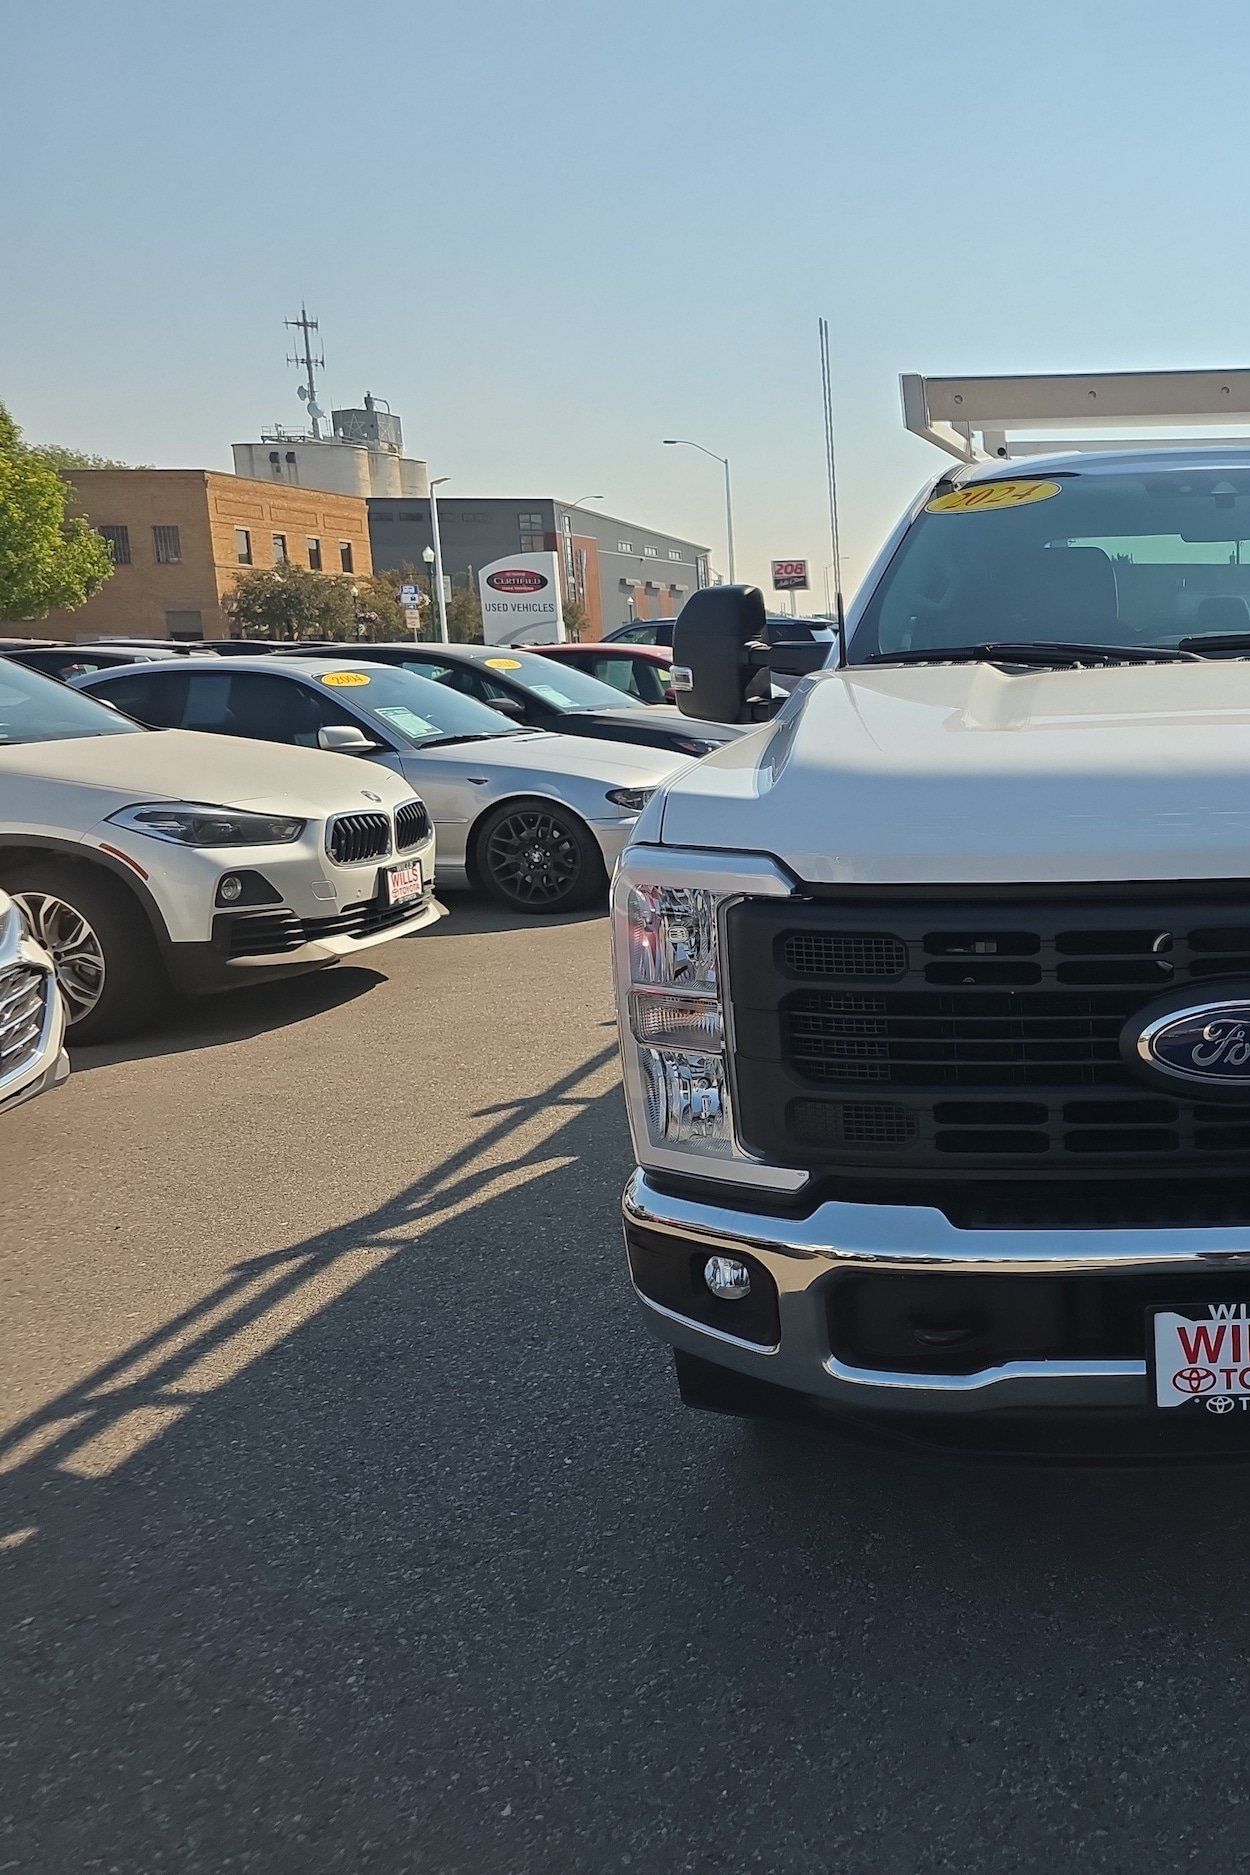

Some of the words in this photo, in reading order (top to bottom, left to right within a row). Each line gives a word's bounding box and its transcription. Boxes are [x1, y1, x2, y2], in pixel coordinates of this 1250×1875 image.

[941, 483, 1044, 510] 2024
[774, 563, 804, 576] 208
[493, 577, 541, 585] CERTIFIED
[485, 603, 509, 613] USED
[511, 603, 555, 613] VEHICLES
[392, 868, 419, 887] WILLS
